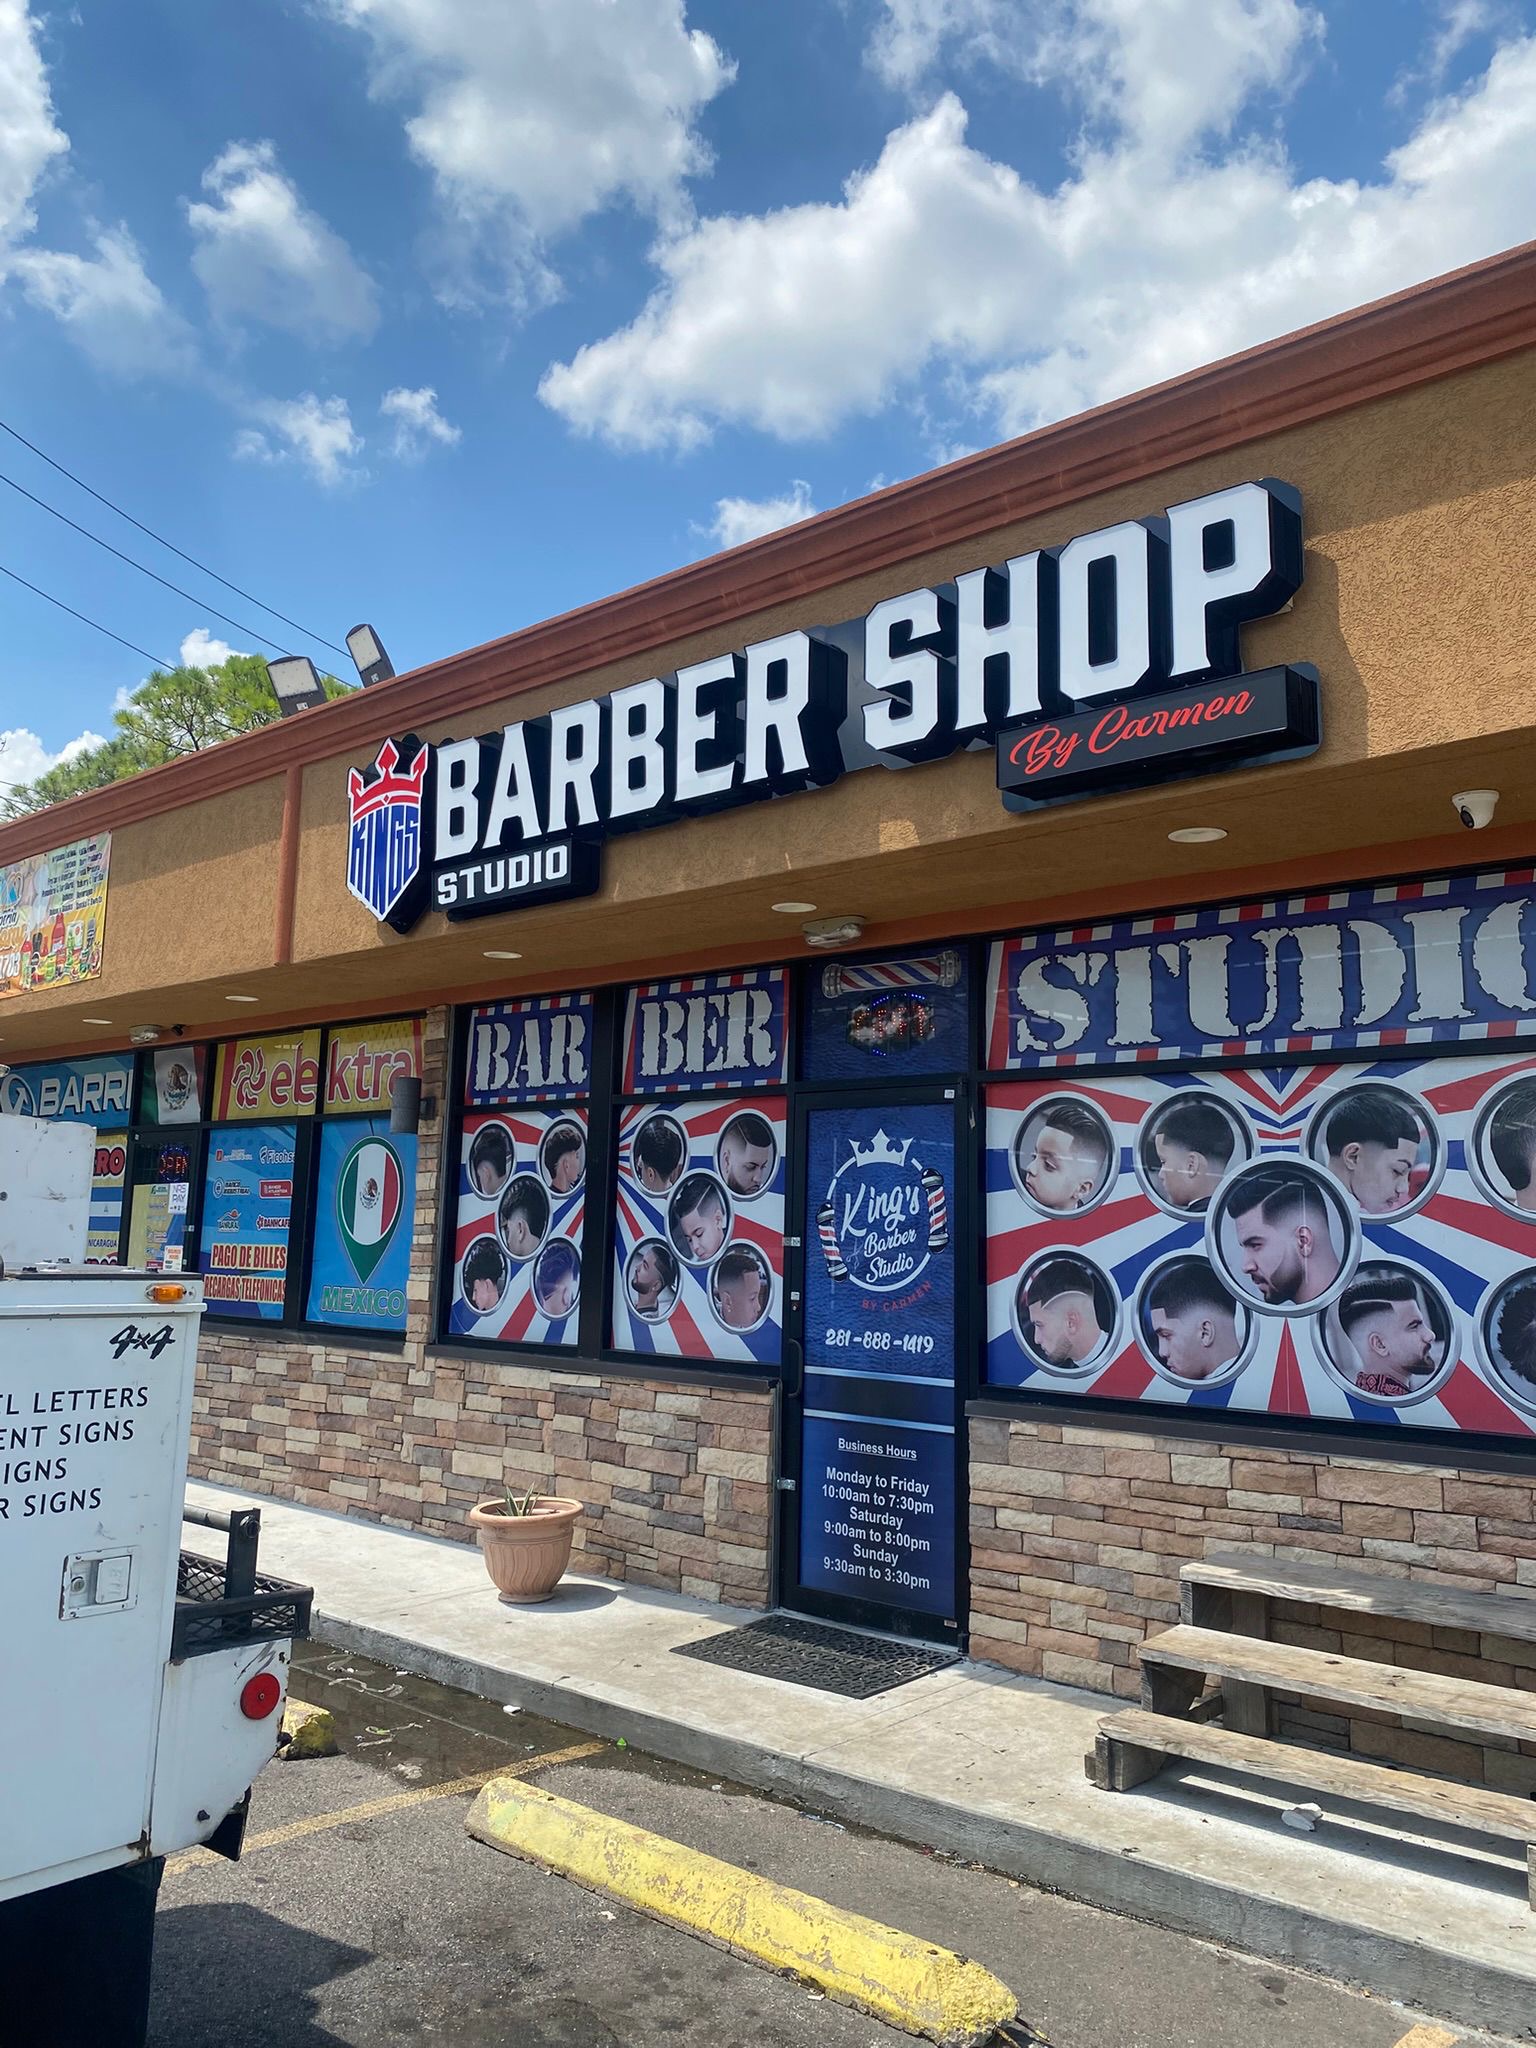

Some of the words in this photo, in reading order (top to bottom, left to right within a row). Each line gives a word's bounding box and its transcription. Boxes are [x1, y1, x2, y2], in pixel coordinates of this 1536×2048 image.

[434, 630, 810, 862] BARBER
[862, 482, 1272, 750] SHOP
[1009, 724, 1083, 774] By
[1088, 691, 1255, 754] Carmen
[349, 804, 419, 915] KINGS
[437, 844, 570, 905] STUDIO
[474, 1013, 588, 1091] BAR
[640, 989, 777, 1076] BER
[39, 1070, 133, 1116] BARRI
[841, 1182, 920, 1242] King's
[88, 1238, 118, 1248] NICARAGUA
[213, 1244, 237, 1267] PAGO
[239, 1246, 252, 1268] DE
[253, 1246, 286, 1269] BILLES
[864, 1228, 917, 1258] Barber
[866, 1253, 914, 1283] Studio
[204, 1275, 240, 1299] RECARGAS
[241, 1277, 286, 1302] TELEFONICAS
[321, 1286, 406, 1317] MEXICO
[861, 1298, 877, 1311] BY
[883, 1280, 932, 1312] CARMEN
[109, 1325, 175, 1359] 4x4
[825, 1328, 935, 1354] 281-888-1419
[33, 1387, 148, 1413] LETTERS
[59, 1420, 134, 1446] SIGNS
[838, 1438, 884, 1455] Business
[886, 1444, 917, 1459] Hours
[826, 1466, 872, 1488] Monday
[875, 1475, 887, 1488] to
[891, 1476, 930, 1496] Friday
[23, 1488, 101, 1517] SIGNS
[822, 1484, 870, 1502] 10:00am
[873, 1493, 886, 1505] to
[889, 1494, 934, 1514] 7:30pm
[850, 1507, 903, 1530] Saturday
[824, 1521, 866, 1540] 9:00am
[869, 1530, 882, 1543] to
[885, 1531, 930, 1551] 8:00pm
[853, 1544, 899, 1566] Sunday
[823, 1557, 866, 1577] 9:30am
[869, 1567, 881, 1580] to
[885, 1567, 930, 1589] 3:30pm
